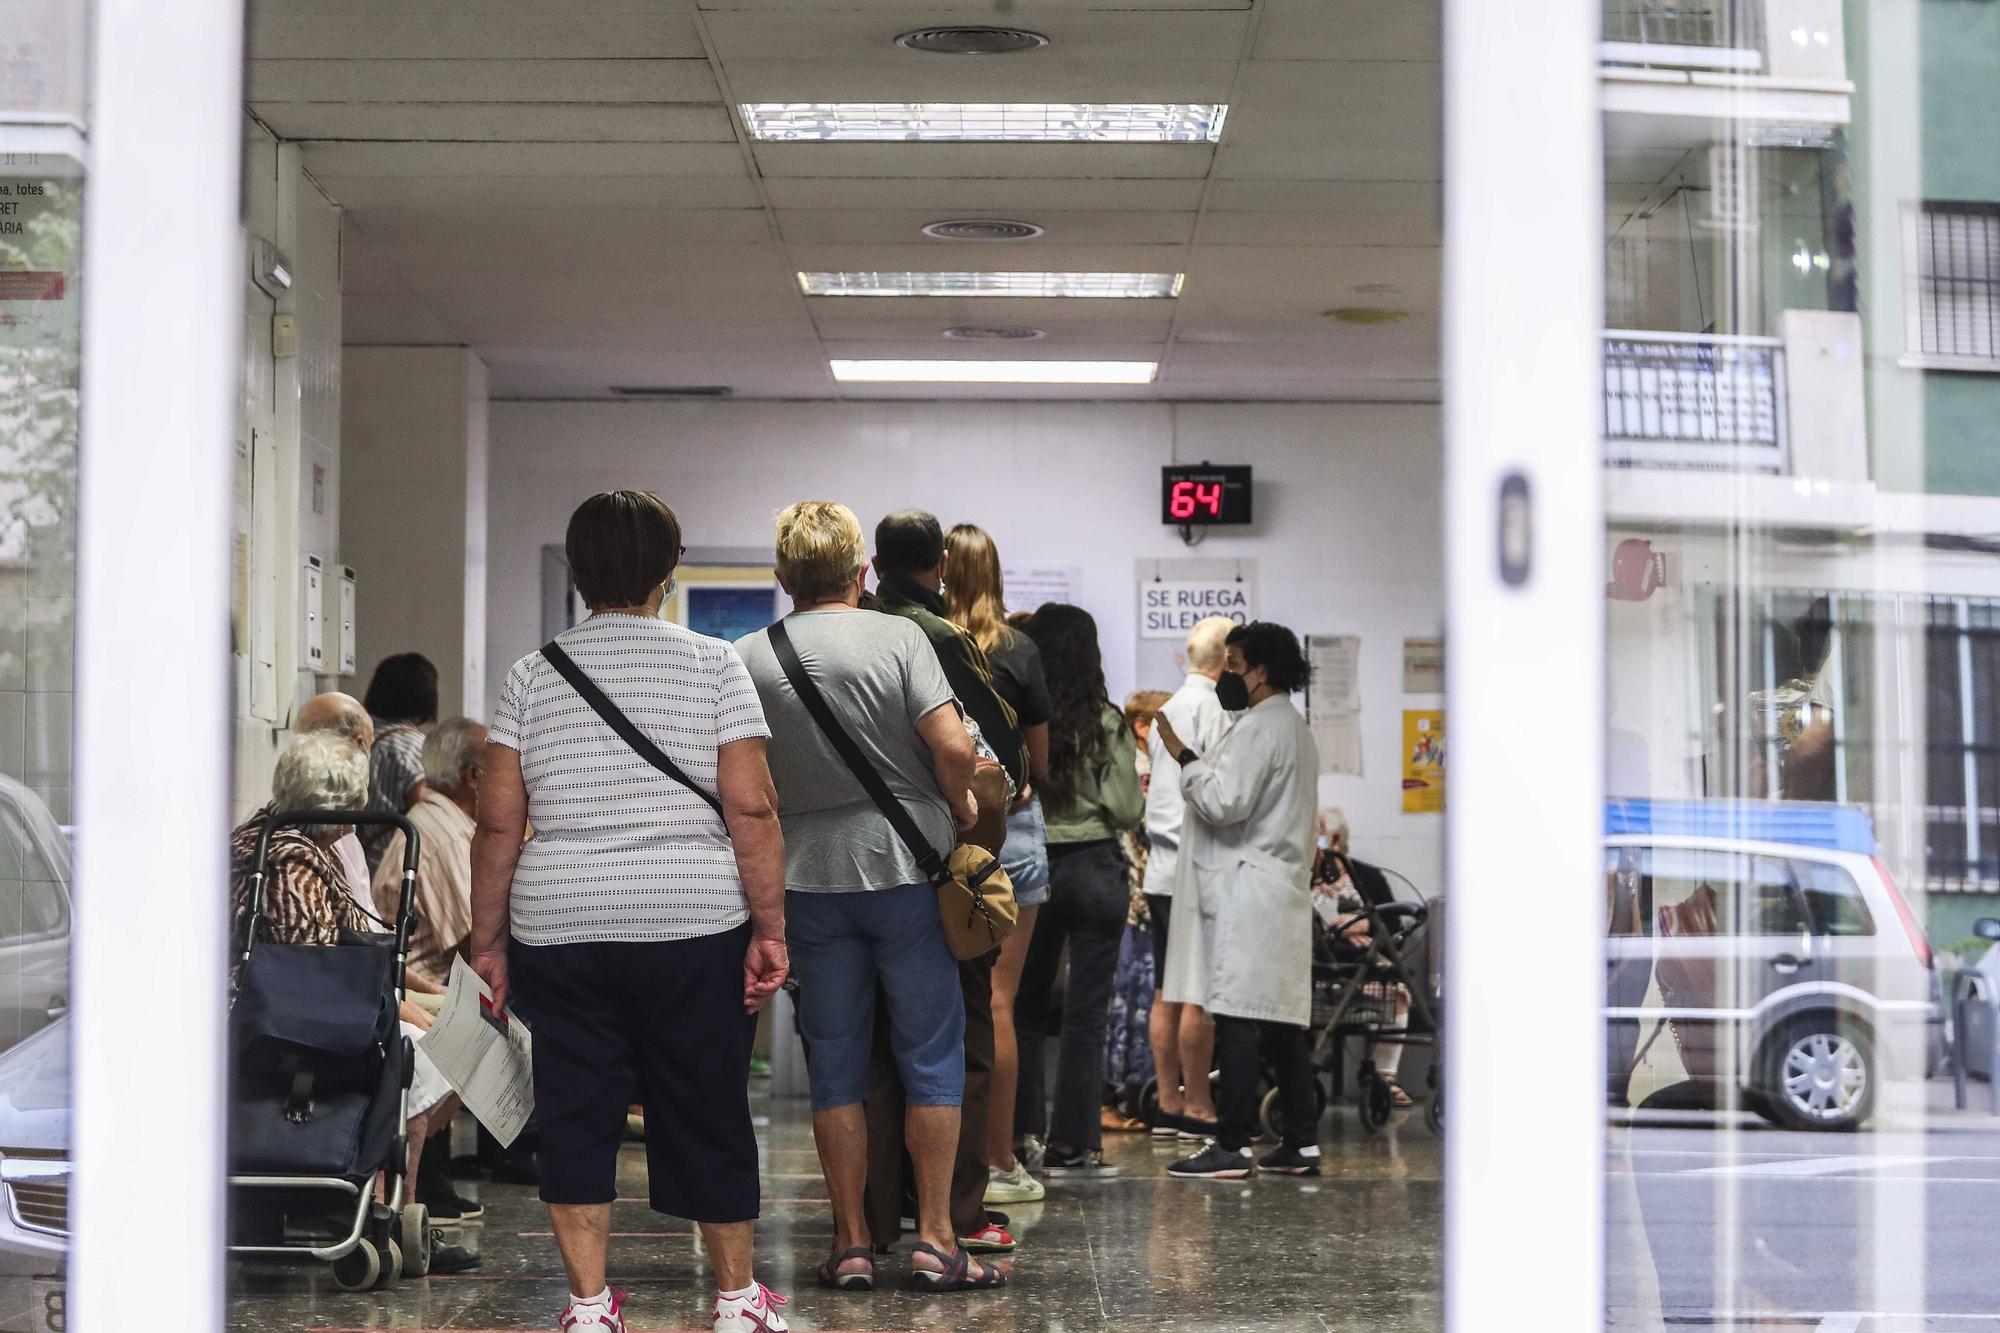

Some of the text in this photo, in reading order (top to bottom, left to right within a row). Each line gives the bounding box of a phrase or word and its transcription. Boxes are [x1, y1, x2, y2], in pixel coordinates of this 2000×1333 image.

[17, 183, 44, 195] totes
[1170, 481, 1221, 518] 64
[1147, 590, 1246, 607] SE RUEGA
